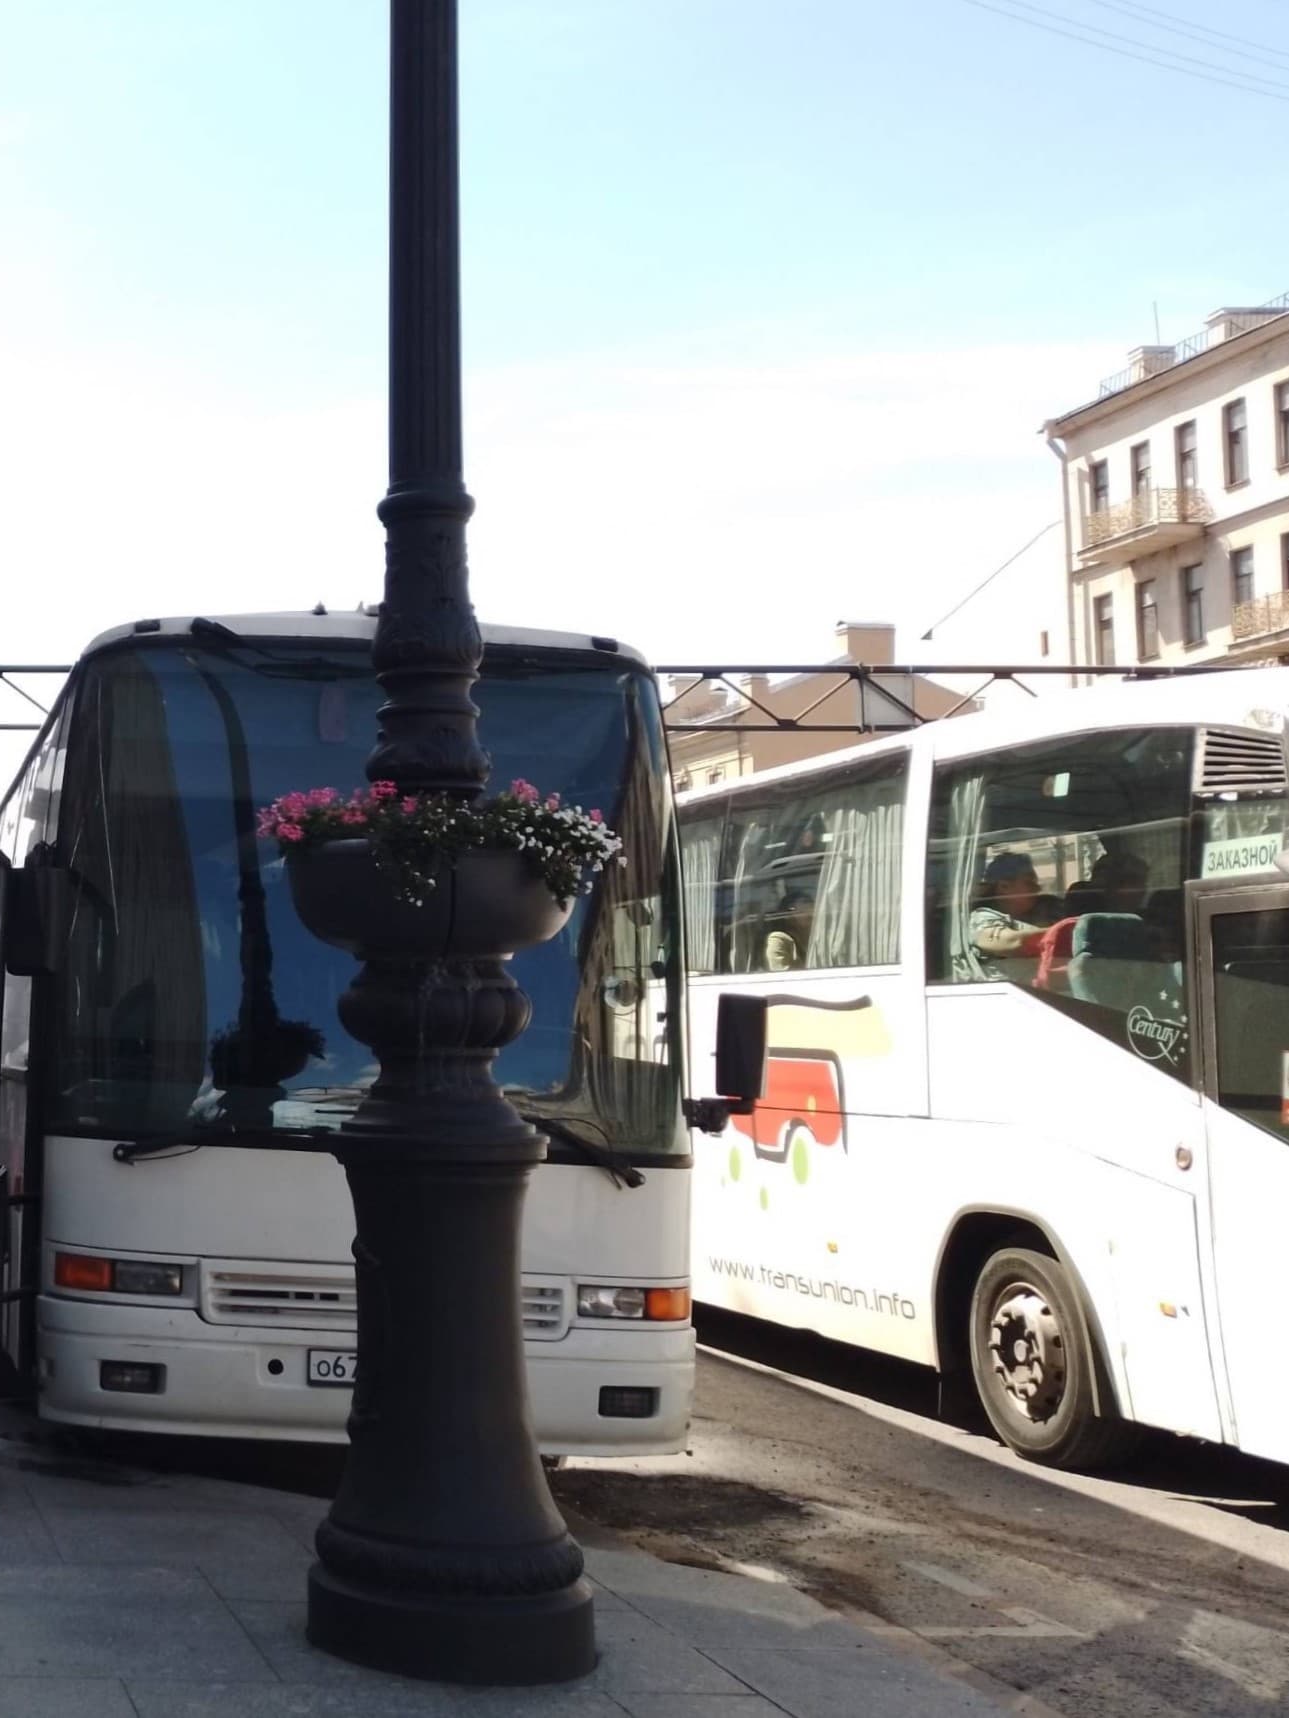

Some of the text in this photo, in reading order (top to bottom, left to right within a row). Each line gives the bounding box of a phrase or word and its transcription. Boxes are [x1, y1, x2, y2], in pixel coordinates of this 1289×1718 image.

[1207, 839, 1278, 872] ЗАКАЗНОЙ
[1129, 1014, 1181, 1050] Century
[708, 1255, 916, 1320] www.transunion.info
